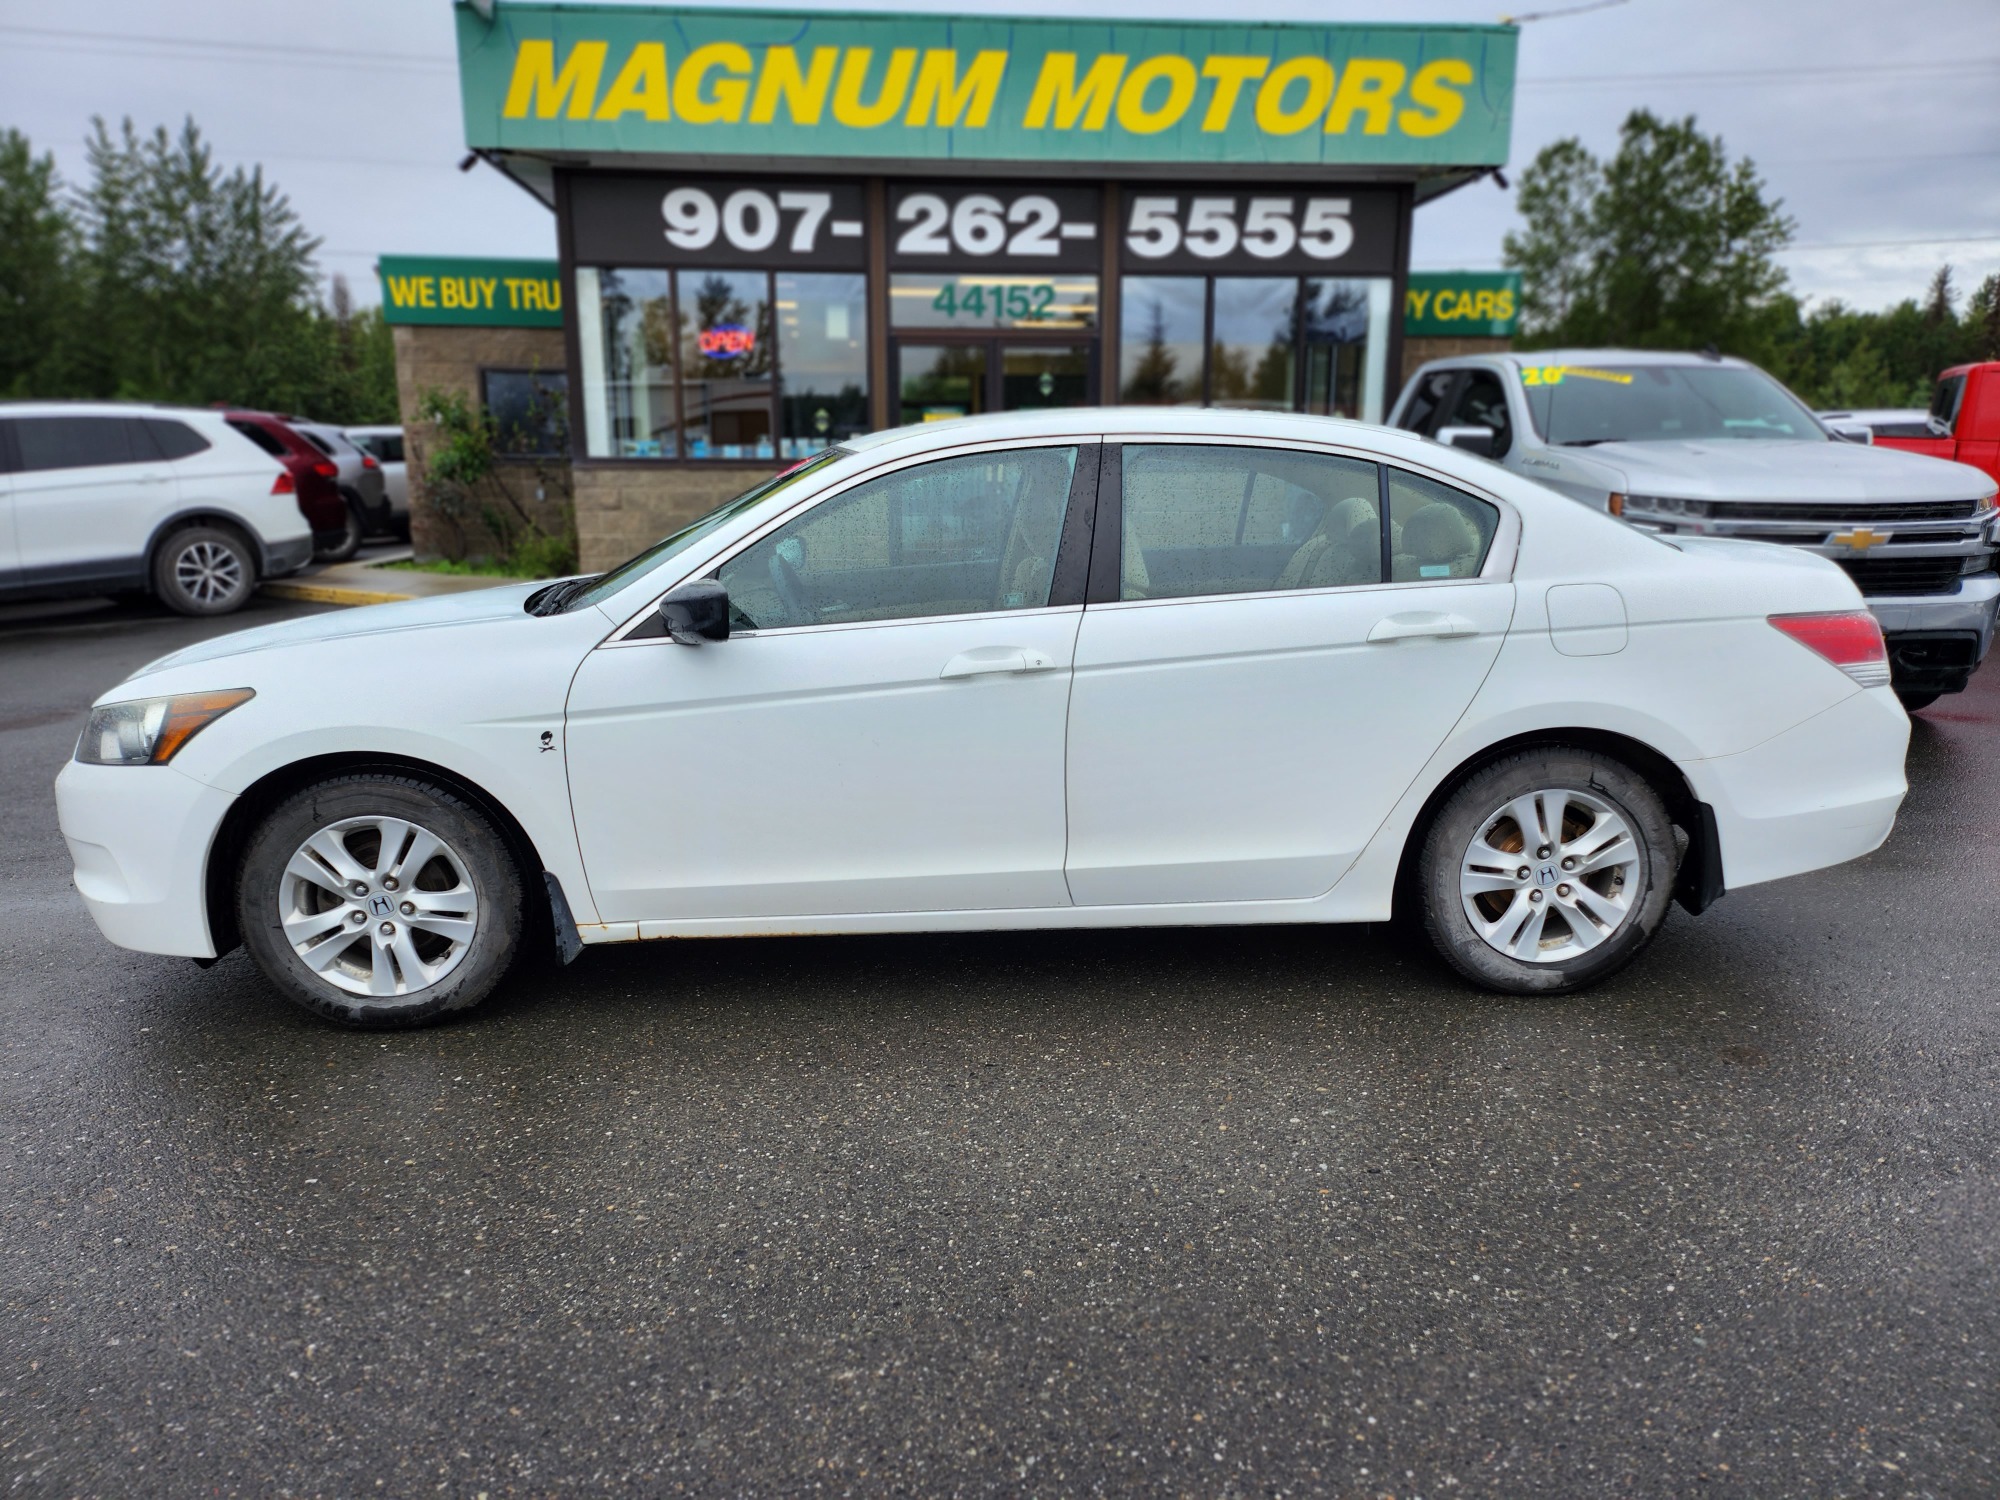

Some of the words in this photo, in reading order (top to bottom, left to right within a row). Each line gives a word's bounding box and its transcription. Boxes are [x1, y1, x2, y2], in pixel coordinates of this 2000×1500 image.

[502, 39, 1009, 128] MAGNUM
[1022, 51, 1473, 137] MOTORS
[662, 188, 863, 252] 907-
[896, 194, 1096, 256] 262-
[1127, 198, 1353, 259] 5555
[387, 275, 437, 308] WE
[439, 276, 497, 310] BUY
[504, 278, 562, 311] TRU
[932, 283, 1057, 319] 44152
[1433, 289, 1515, 321] CARS
[699, 329, 755, 353] OPEN
